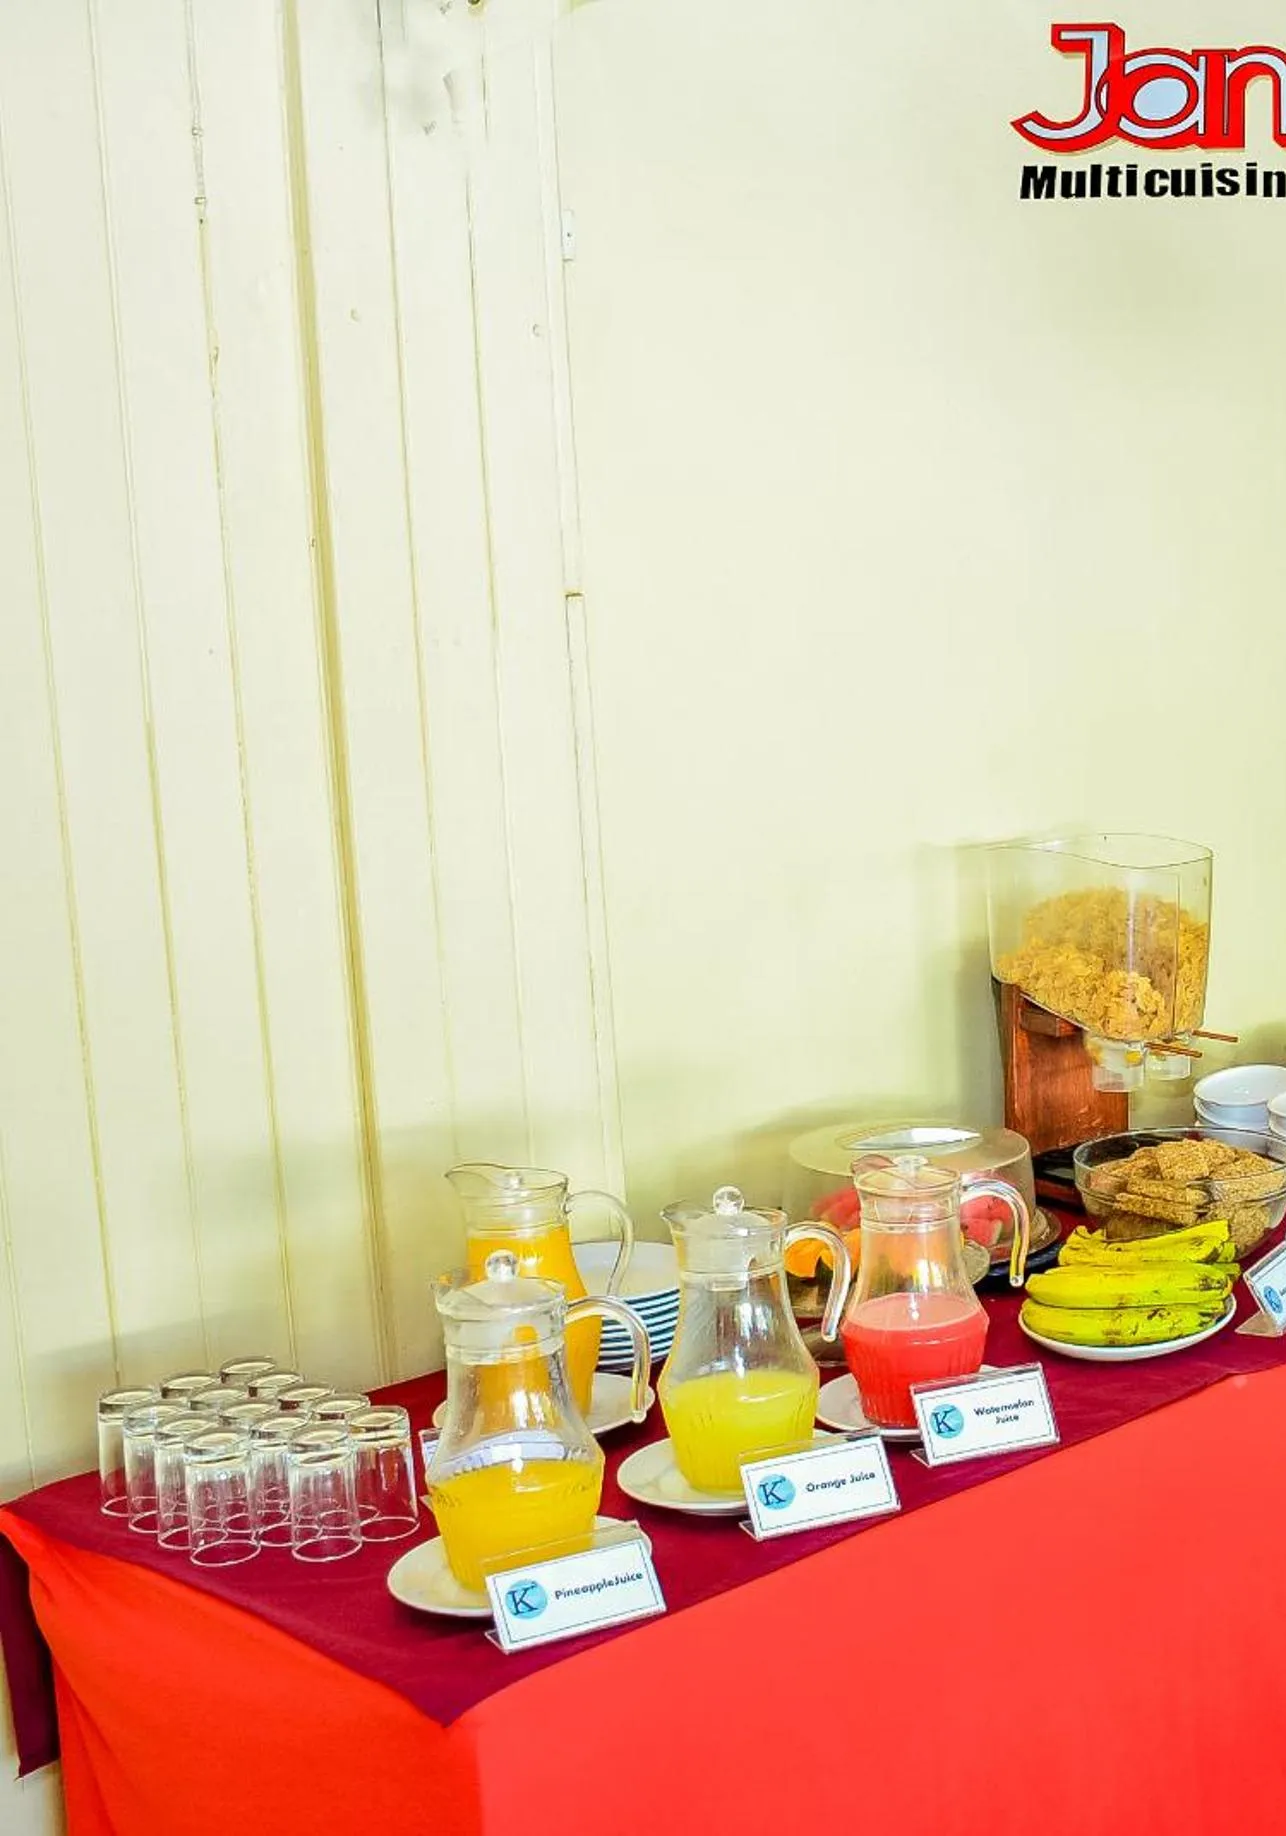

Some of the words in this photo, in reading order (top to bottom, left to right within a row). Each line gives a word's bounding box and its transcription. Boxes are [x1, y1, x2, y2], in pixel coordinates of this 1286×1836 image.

[932, 1406, 956, 1434] K
[974, 1398, 1035, 1417] Watermelon
[995, 1415, 1020, 1425] Juice
[758, 1475, 787, 1506] K
[806, 1477, 847, 1493] Orange
[849, 1471, 876, 1484] Juice
[506, 1581, 539, 1616] K
